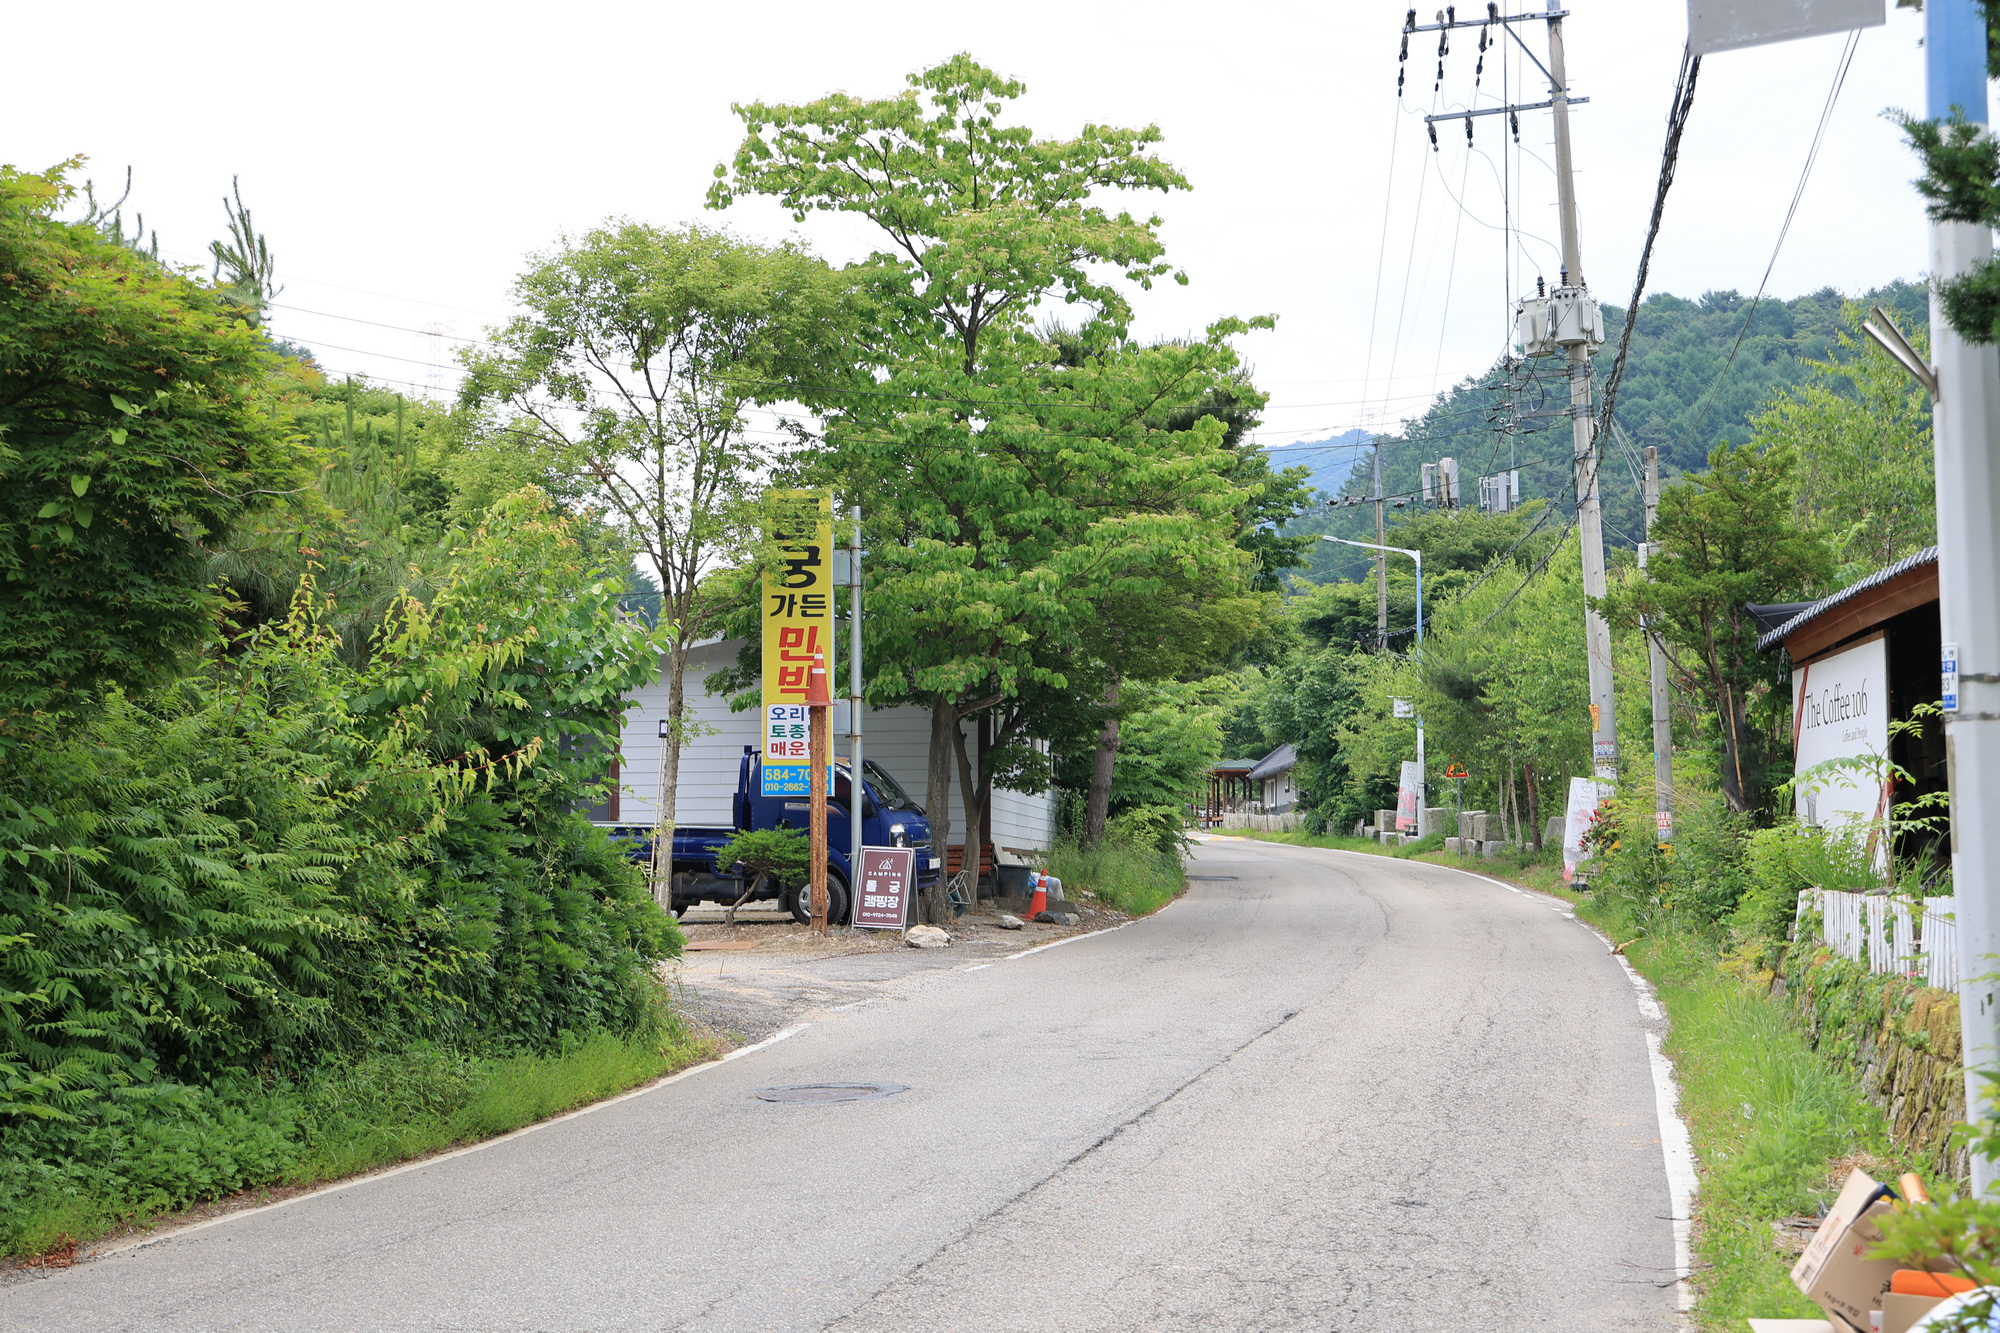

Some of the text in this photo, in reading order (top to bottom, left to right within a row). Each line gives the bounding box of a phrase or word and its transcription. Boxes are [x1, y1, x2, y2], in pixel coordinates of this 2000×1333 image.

[770, 594, 826, 617] 가든
[1805, 678, 1868, 729] The Coffee 106
[770, 707, 811, 721] 오리
[770, 724, 811, 739] 토종
[770, 741, 811, 756] 매운
[864, 895, 899, 908] 캠핑장
